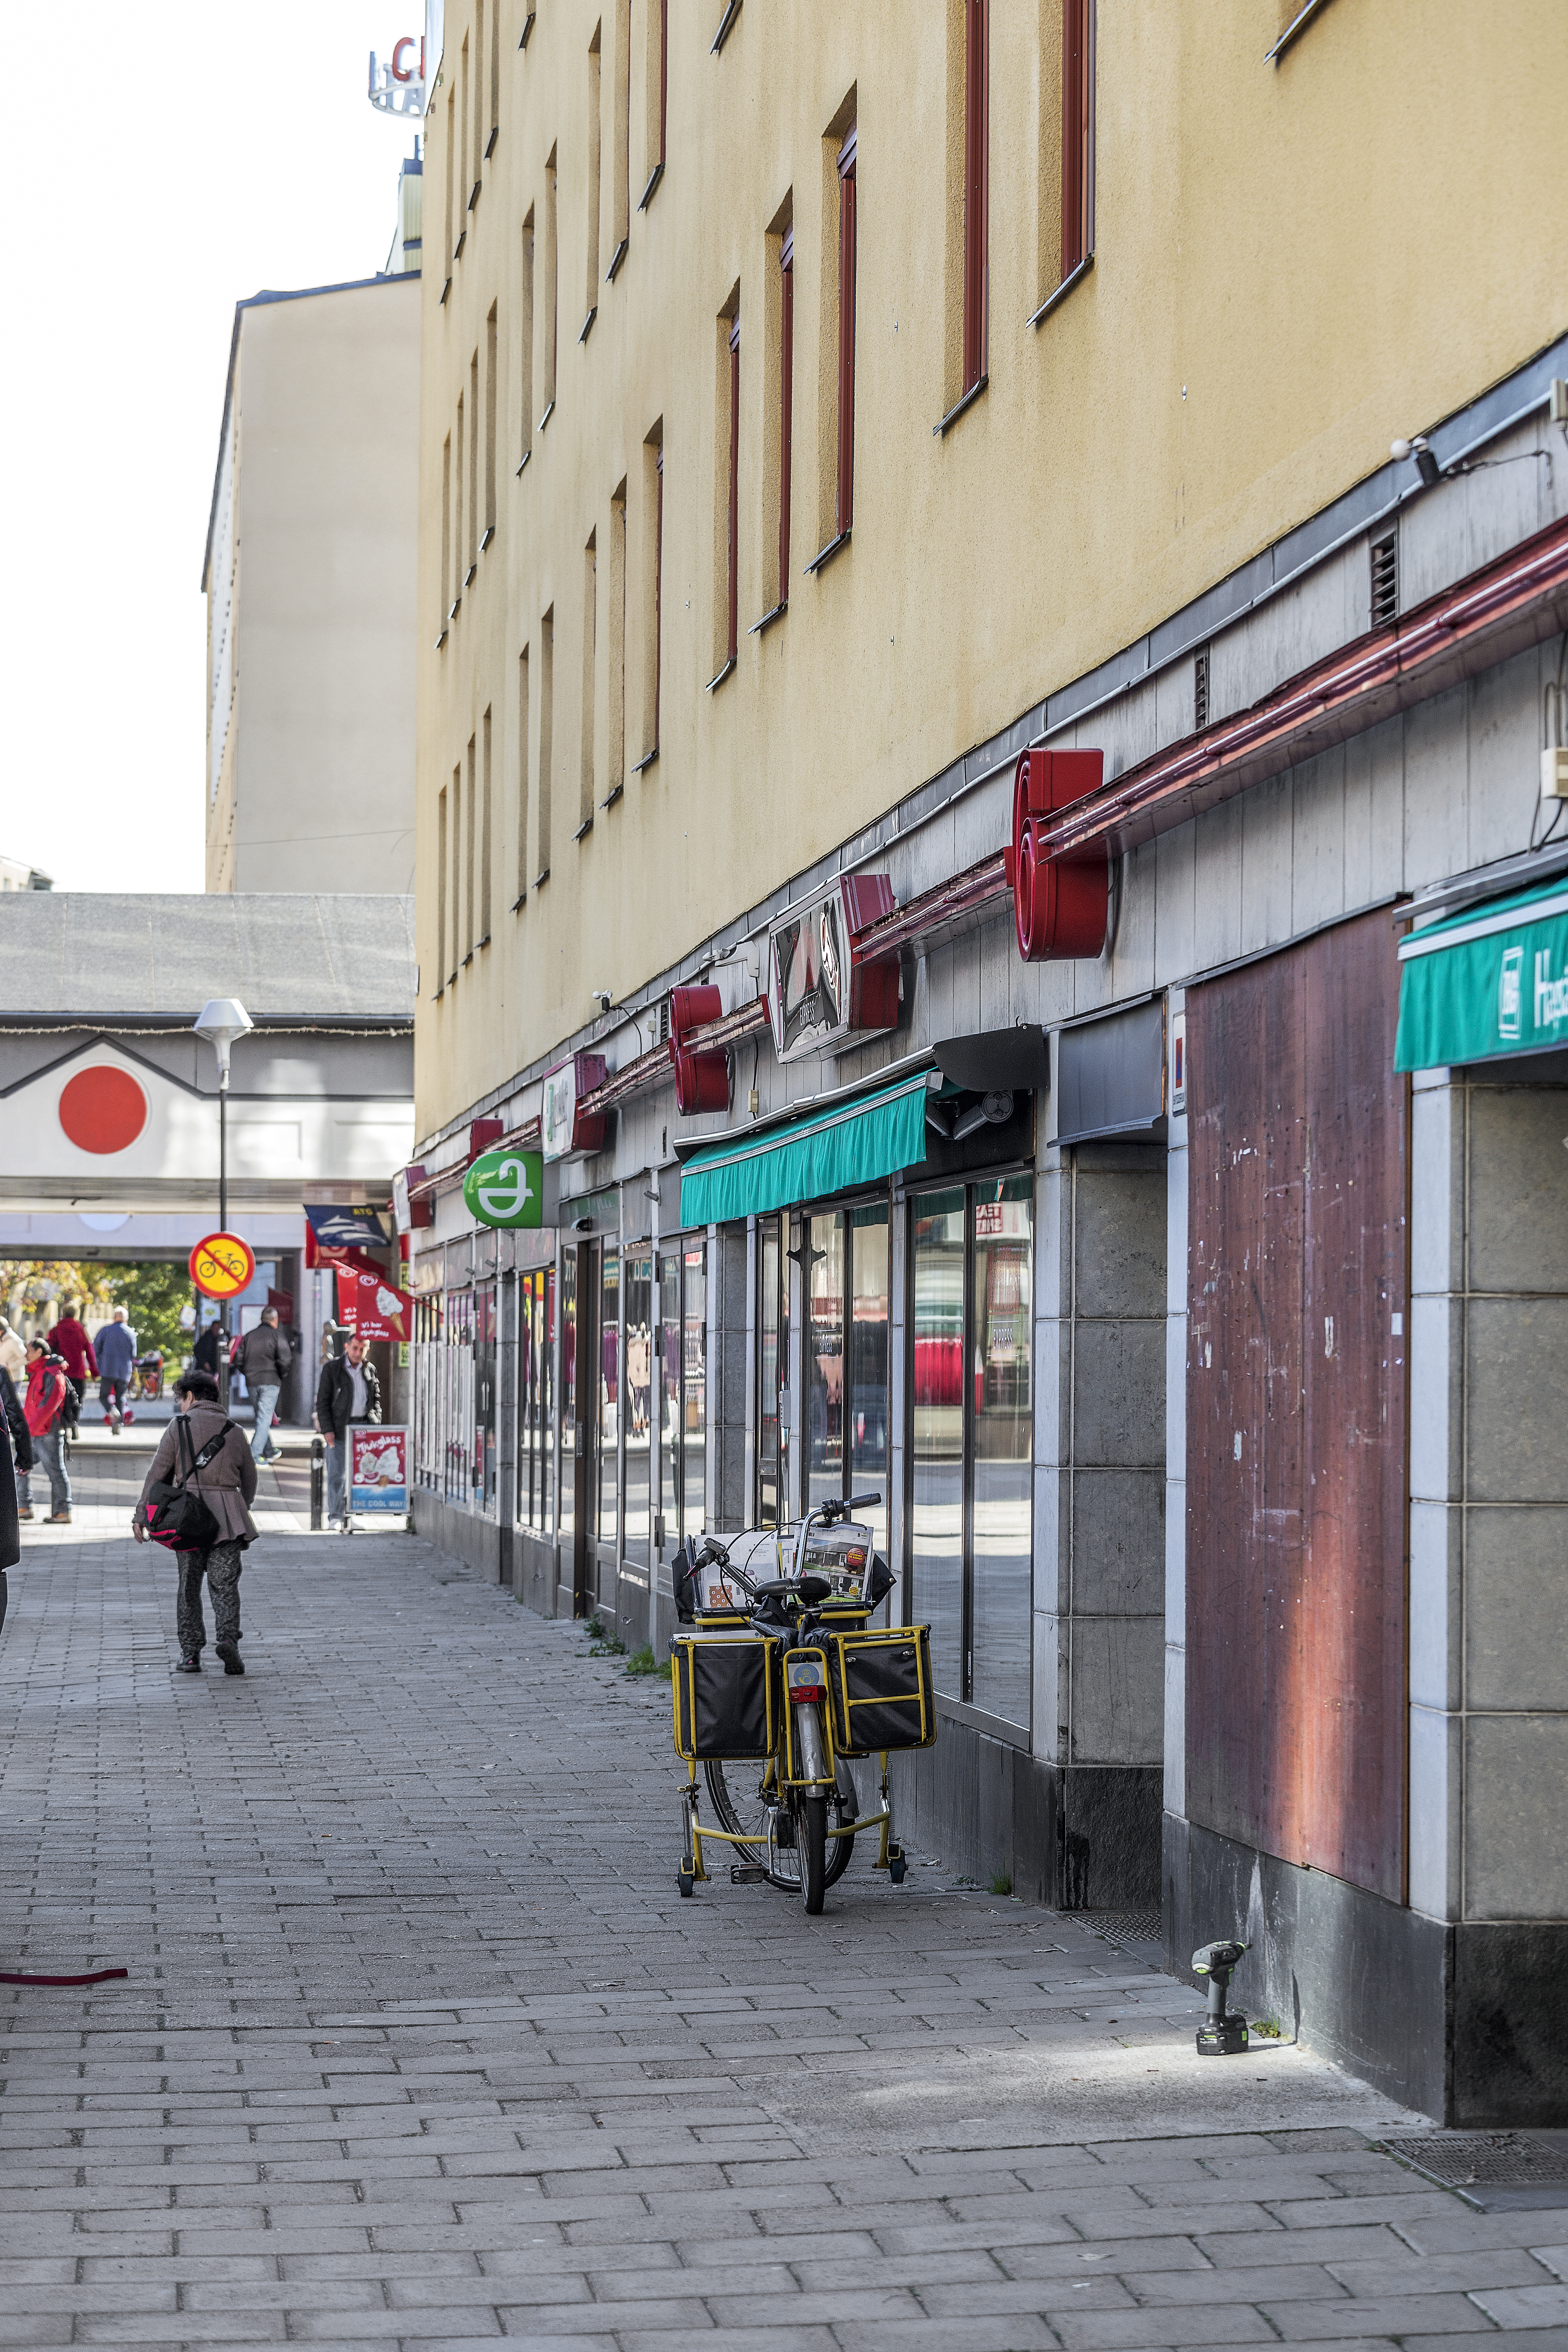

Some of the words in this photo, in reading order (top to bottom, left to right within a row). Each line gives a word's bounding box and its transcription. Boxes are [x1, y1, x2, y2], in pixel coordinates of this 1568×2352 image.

[799, 1000, 815, 1026] EXPRESS
[819, 1334, 833, 1353] EXPRESS
[993, 1328, 1013, 1350] EXPRESS
